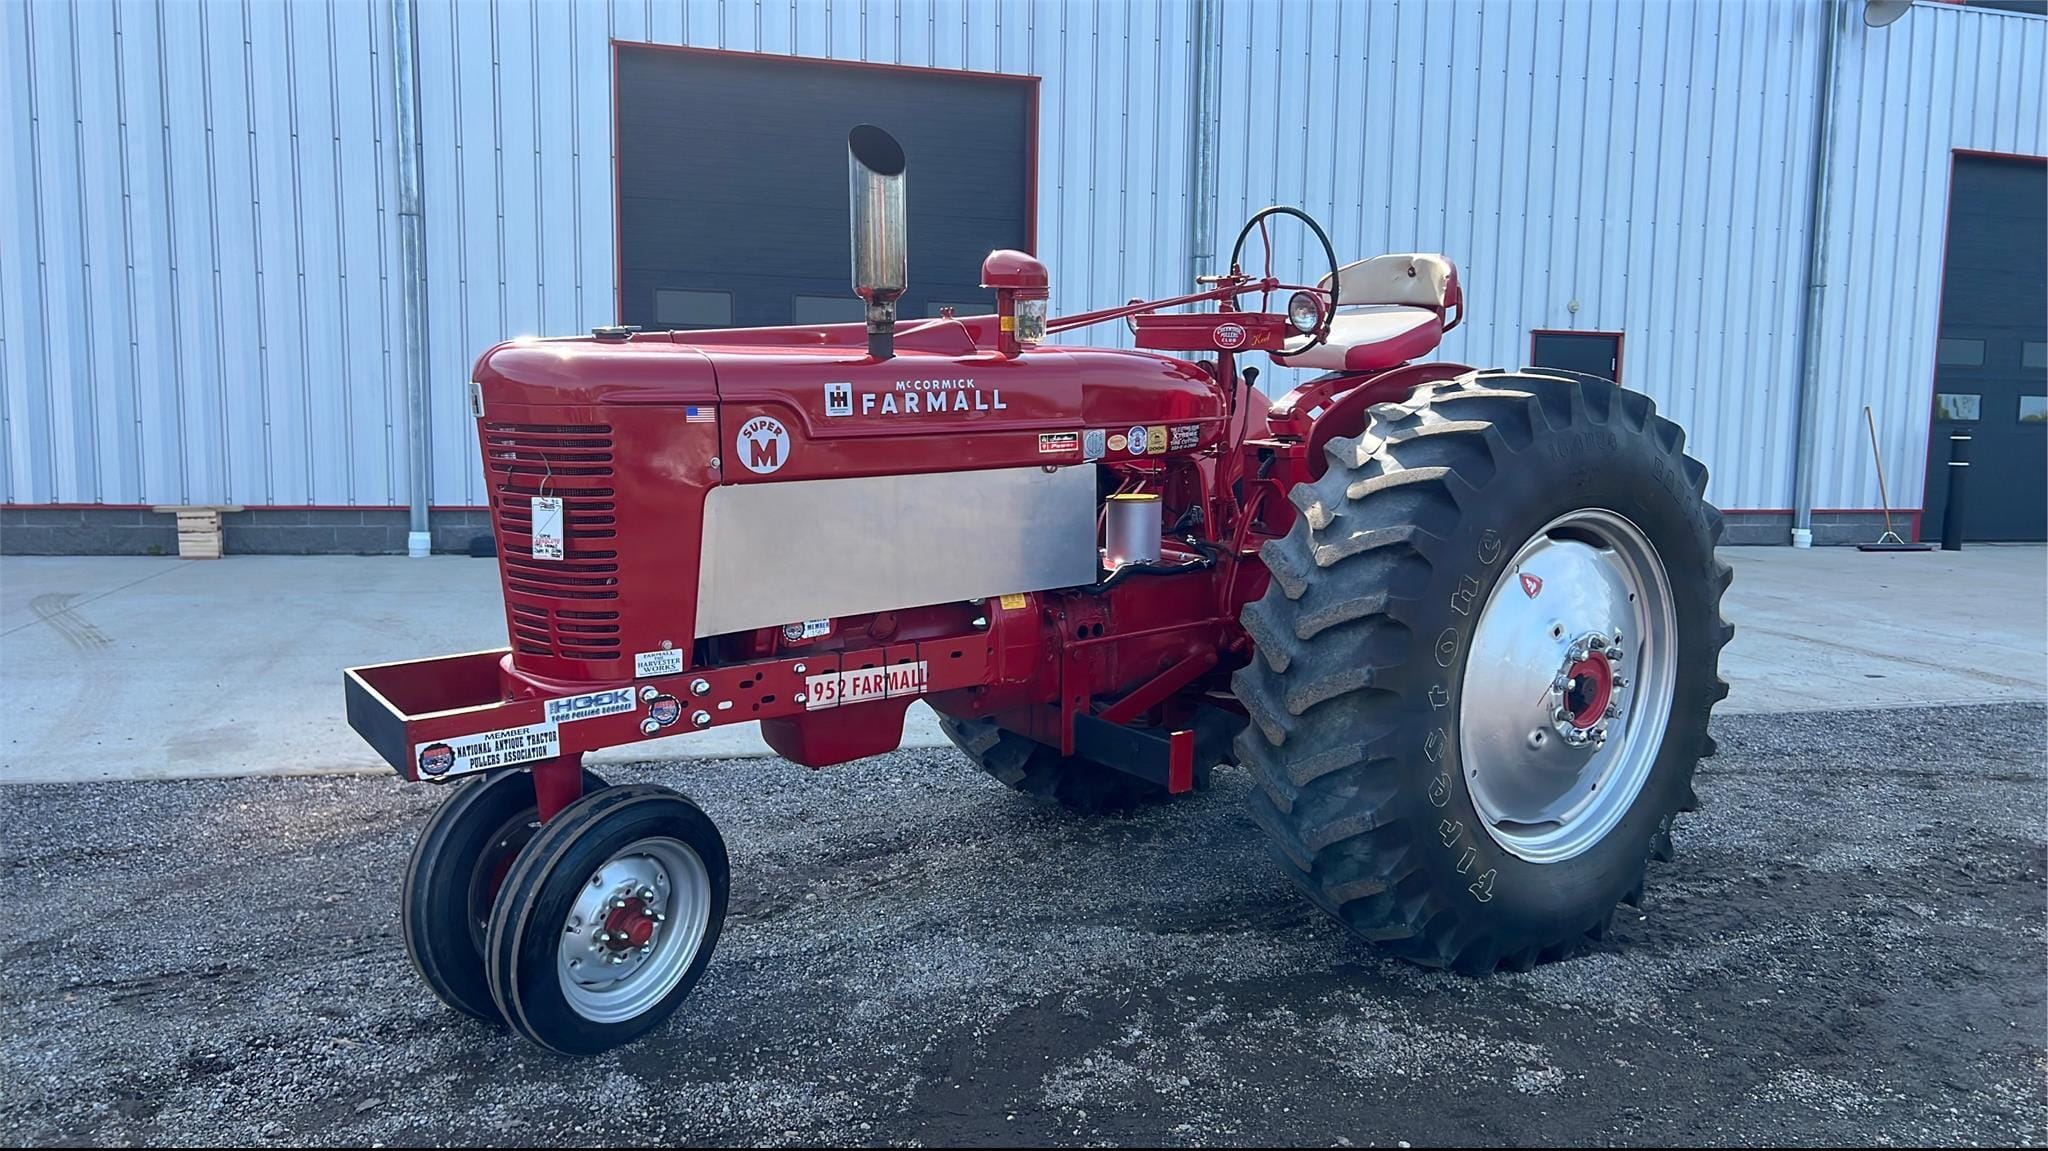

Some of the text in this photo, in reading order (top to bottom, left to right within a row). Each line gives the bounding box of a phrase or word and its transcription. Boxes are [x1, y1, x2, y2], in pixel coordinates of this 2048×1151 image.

[862, 389, 1007, 415] FARMALL
[743, 420, 783, 439] SUPER
[750, 439, 778, 467] M
[637, 657, 681, 669] HARVESTER
[643, 664, 676, 673] WORKS
[805, 668, 927, 702] 1952 FARMALL
[556, 689, 631, 714] HOOK
[456, 742, 491, 758] NATIONAL
[494, 736, 524, 752] ANTIQUE
[526, 731, 557, 746] TRACTOR
[484, 727, 530, 741] MEMBER
[469, 746, 548, 769] PULLERS ASSOCIATION
